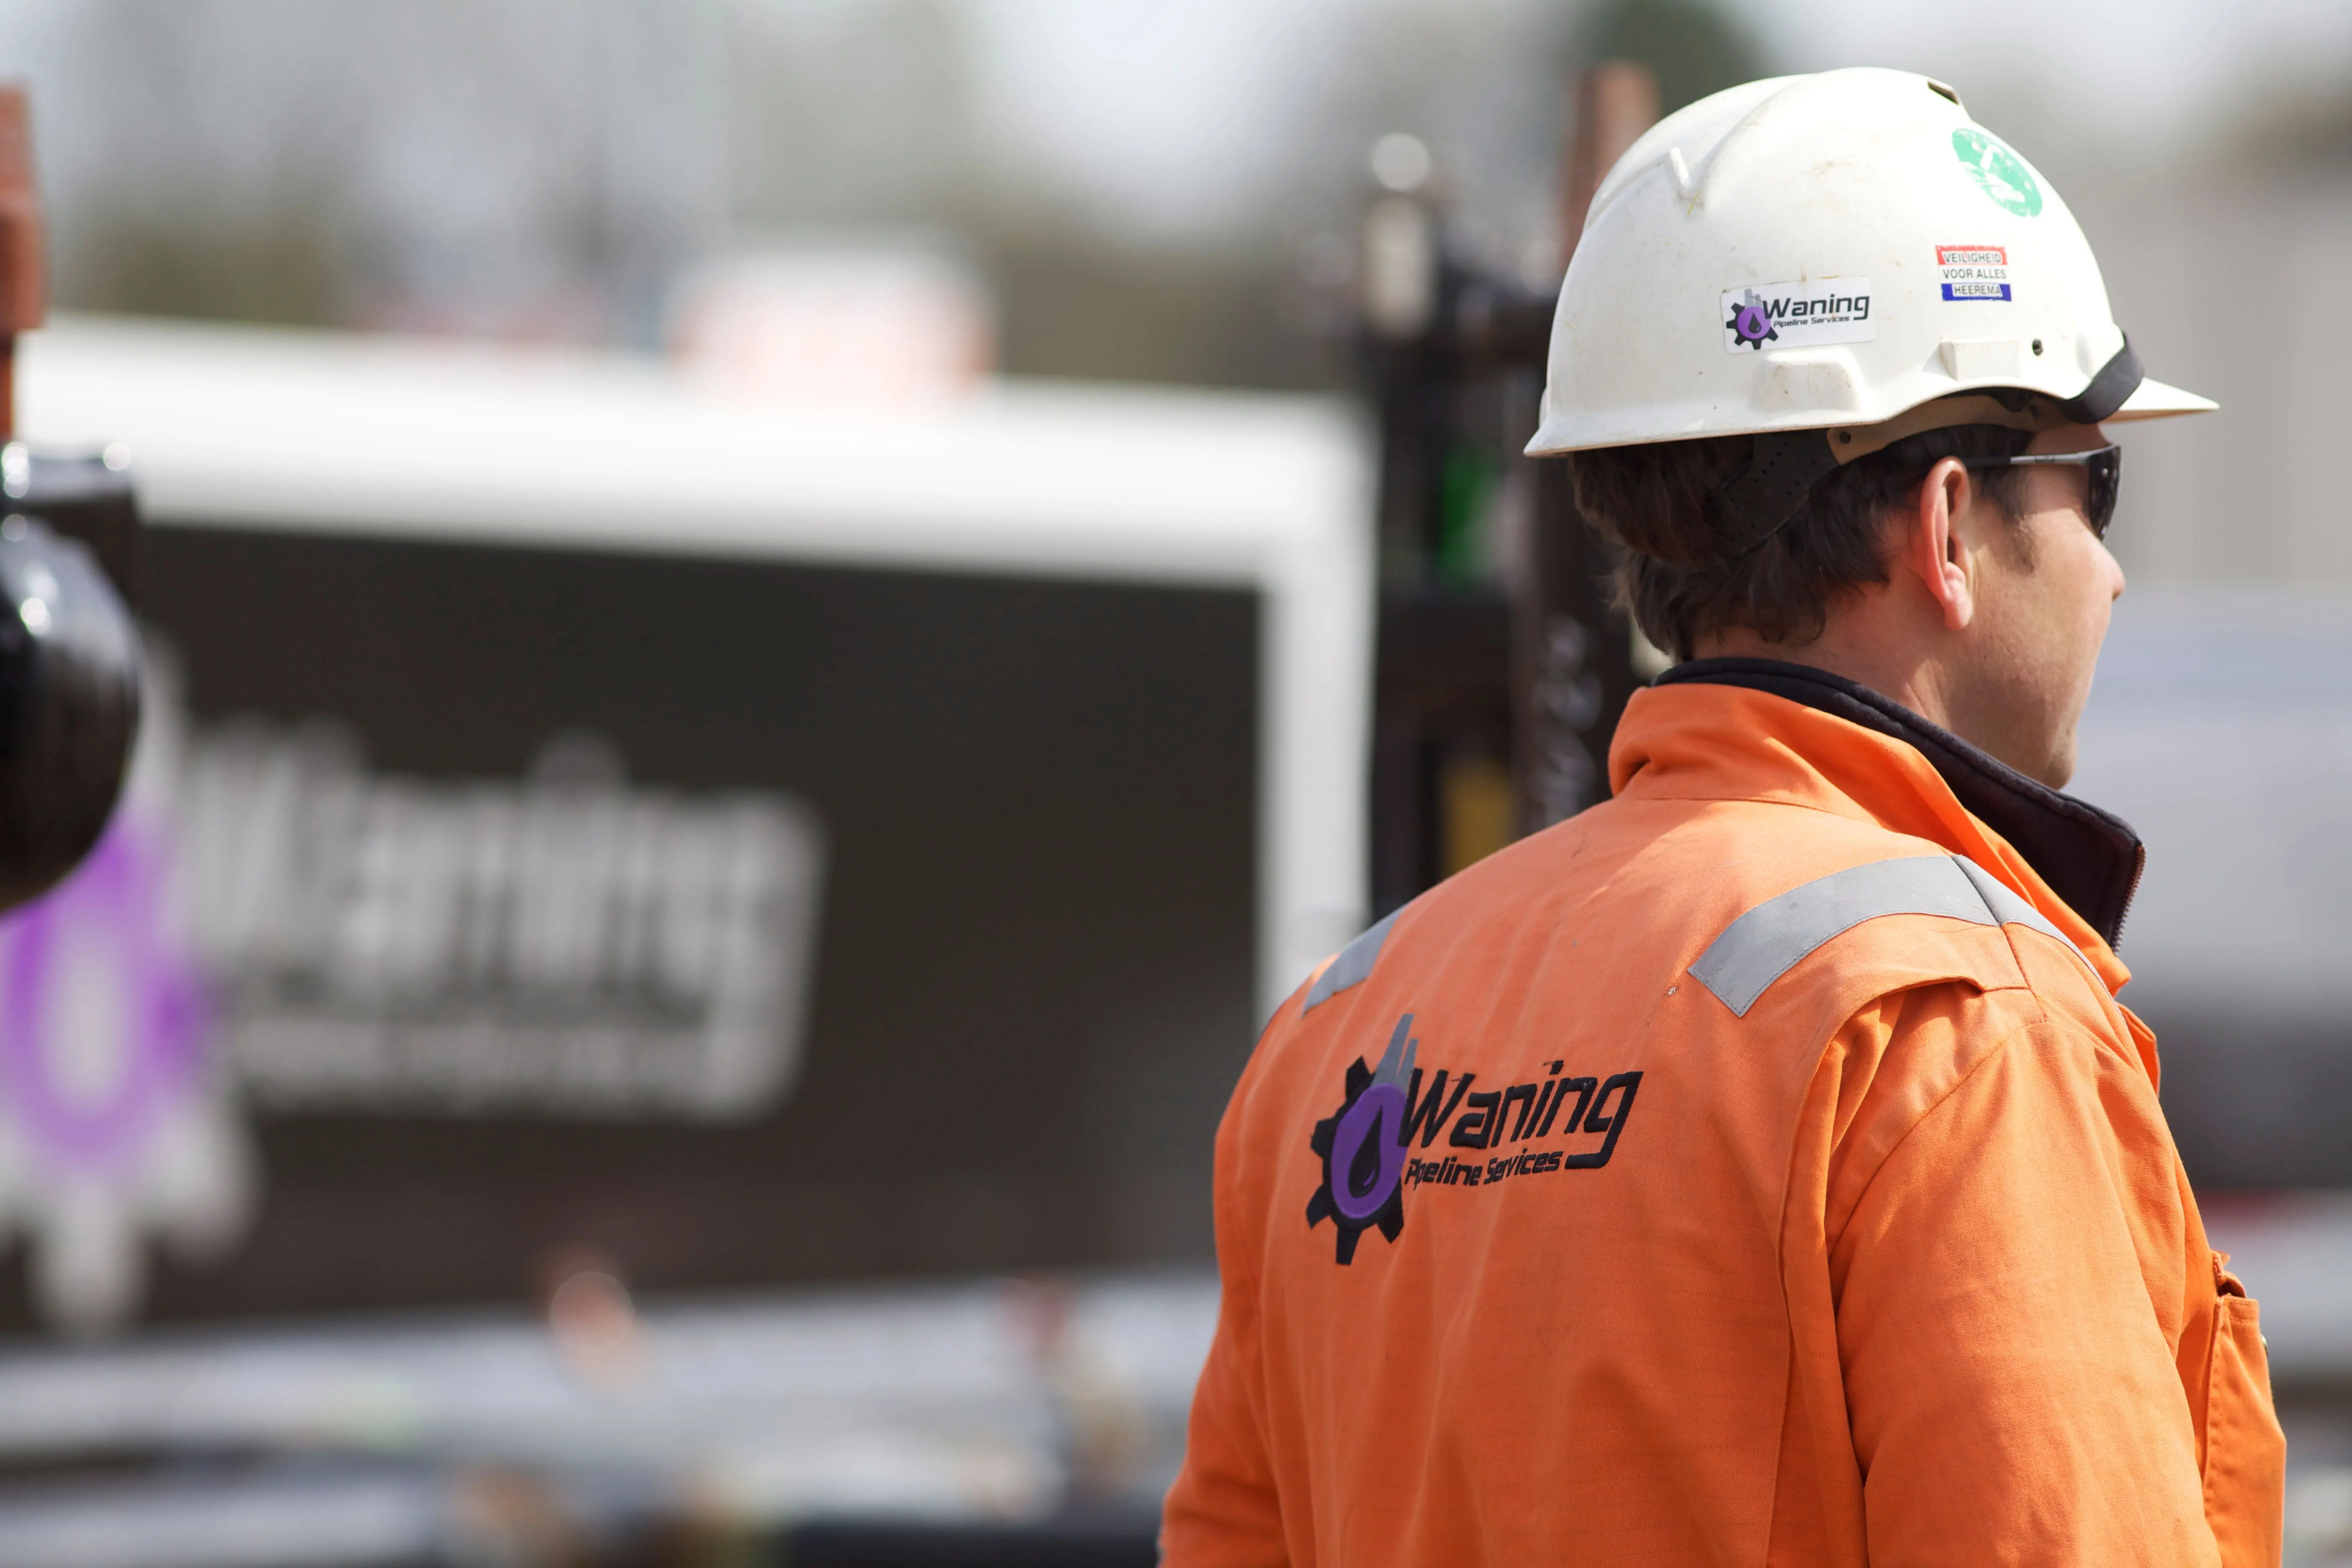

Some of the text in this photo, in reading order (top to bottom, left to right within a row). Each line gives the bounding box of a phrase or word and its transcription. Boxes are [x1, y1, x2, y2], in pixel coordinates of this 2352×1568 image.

[1945, 253, 2001, 263] VEILIGHEID
[1943, 268, 2006, 279] VOOR ALLES
[1955, 285, 2001, 294] HEEREMA
[1762, 294, 1870, 320] Waning
[1773, 315, 1850, 328] Pipeline Services
[1398, 1060, 1643, 1168] Waning
[1404, 1148, 1564, 1191] Ppeline Services
